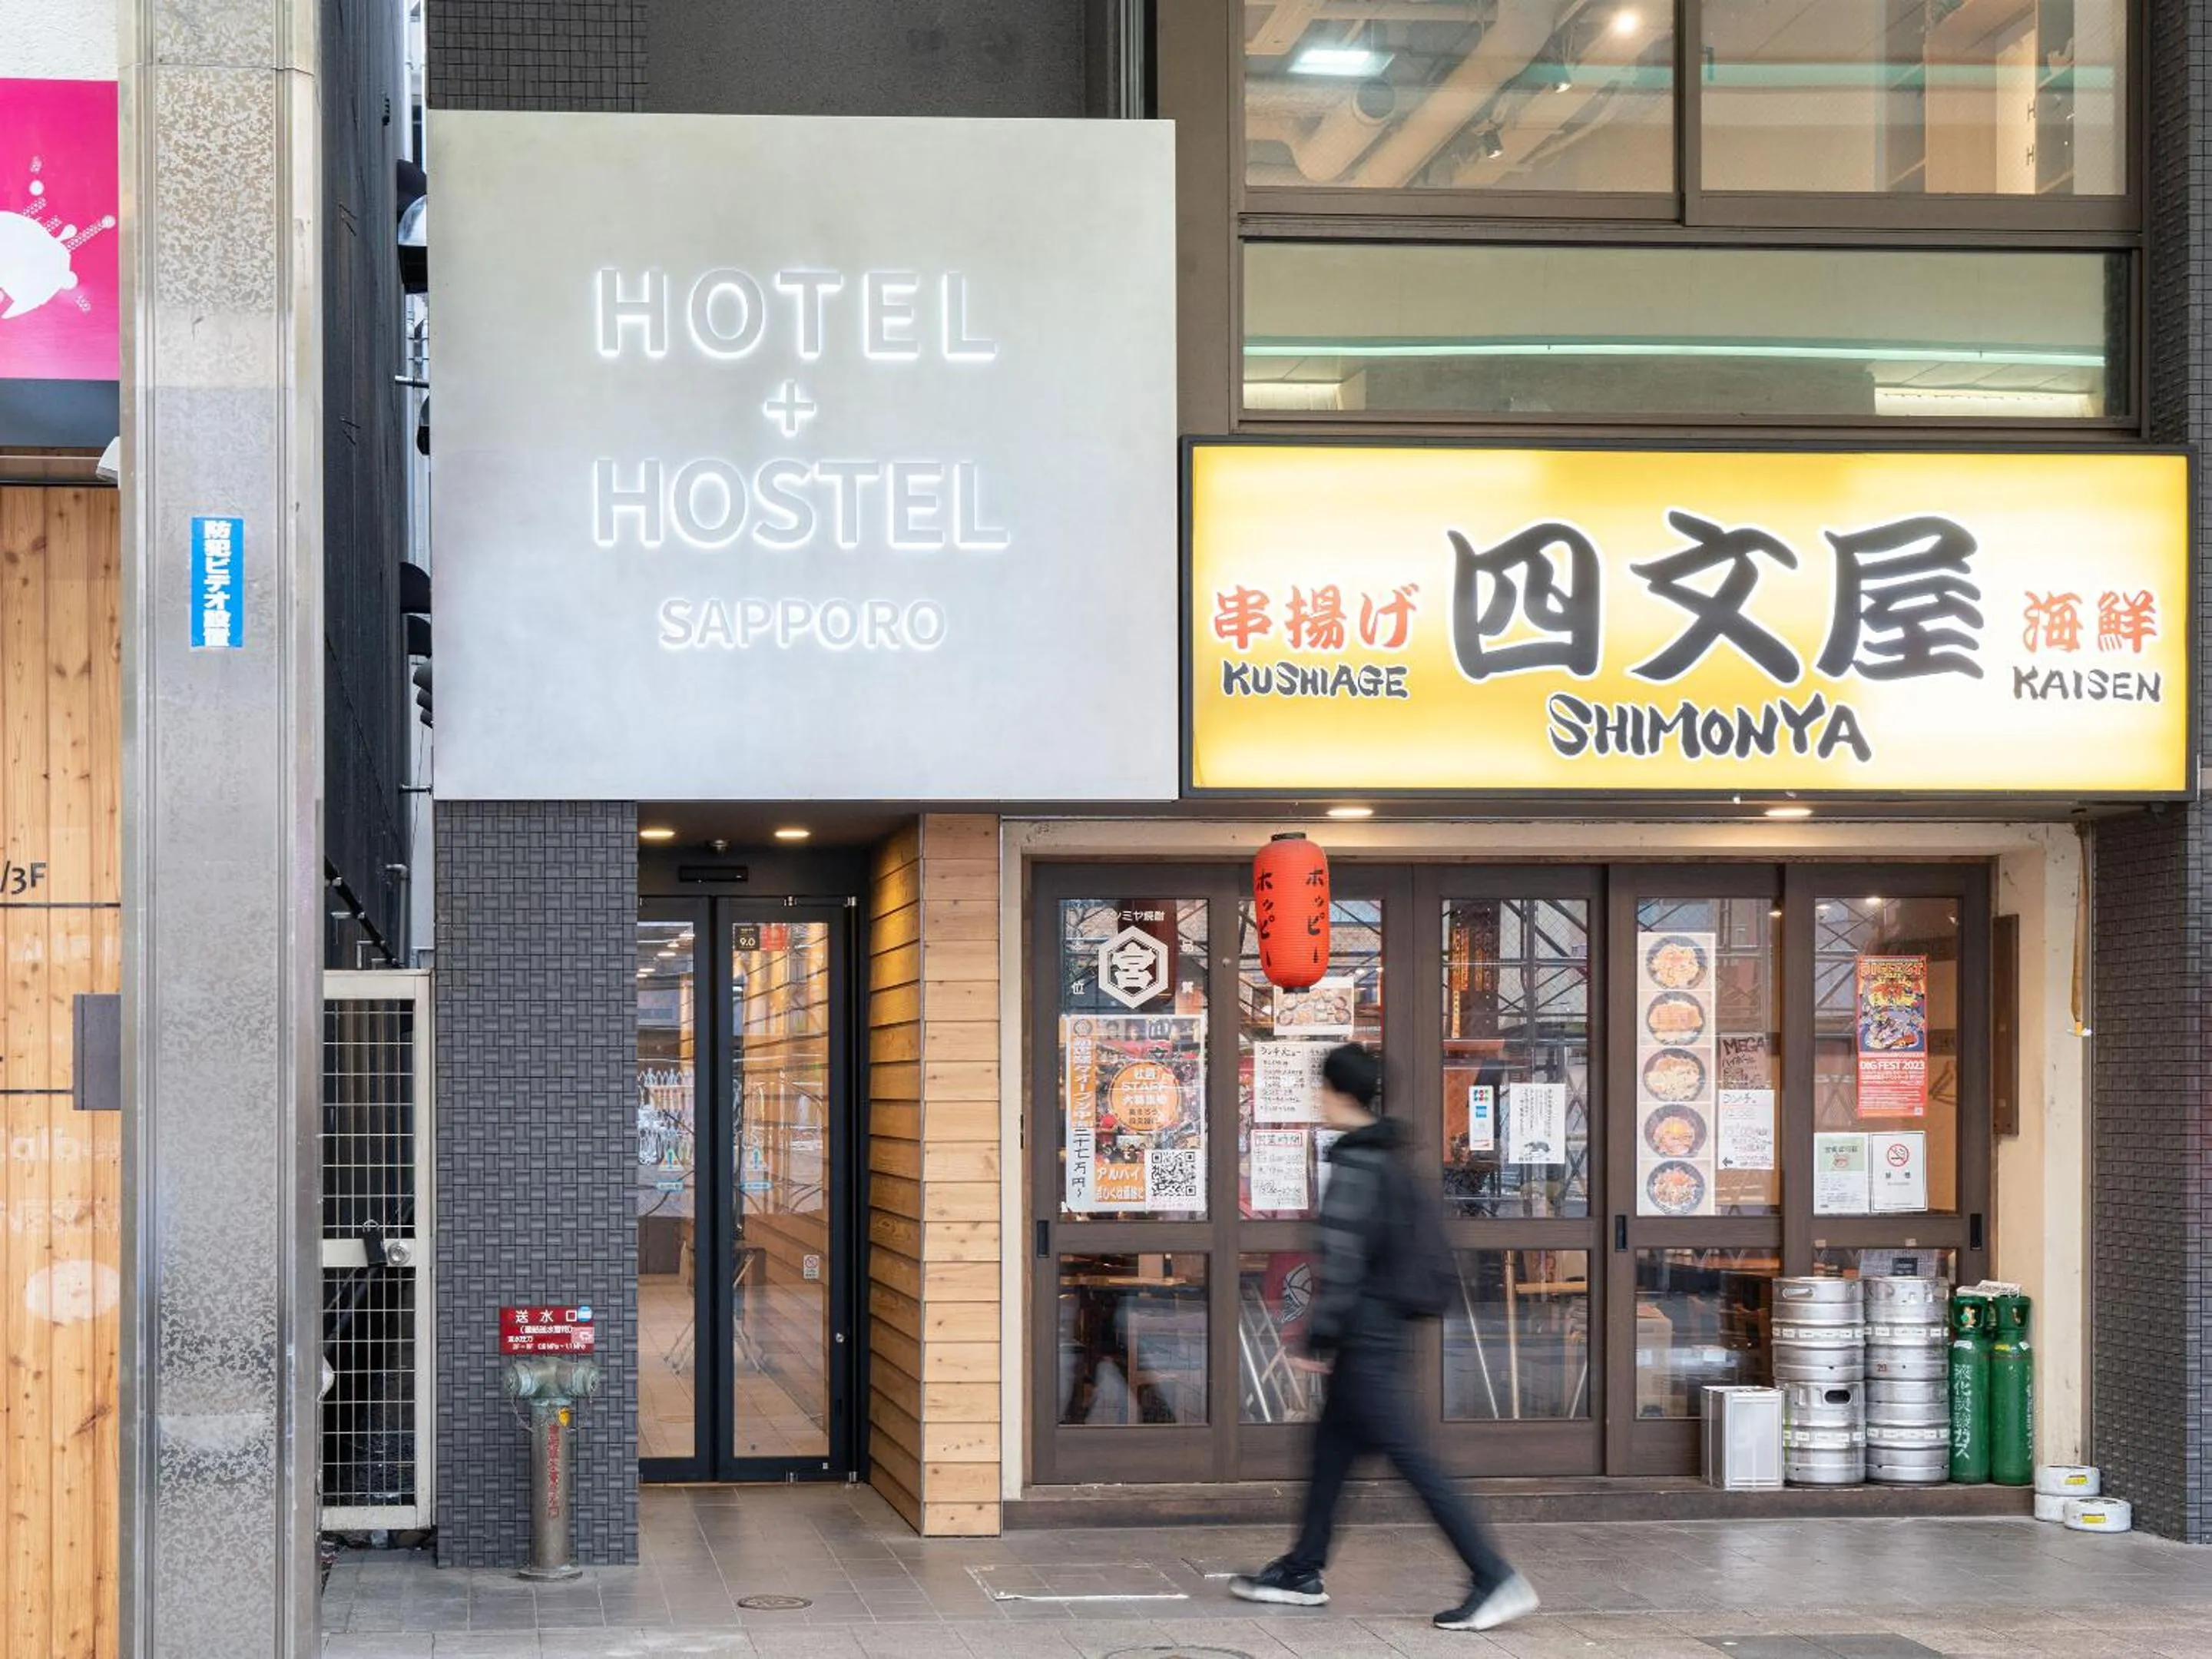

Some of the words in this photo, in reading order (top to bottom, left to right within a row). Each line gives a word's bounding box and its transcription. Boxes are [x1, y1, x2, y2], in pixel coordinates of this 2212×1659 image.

[598, 269, 997, 358] HOTEL
[594, 459, 1010, 548] HOSTEL
[660, 598, 945, 650] SAPPORO
[1214, 584, 1419, 650] 串揚げ
[1447, 511, 1984, 683] 四文屋
[2022, 590, 2159, 653] 海鮮
[1223, 661, 1409, 697] KUSHIAGE
[2012, 664, 2162, 702] KAISEN
[1548, 694, 1873, 762] SHIMONYA
[739, 937, 756, 947] 9.0
[1256, 869, 1275, 968] ホッピー
[1306, 868, 1326, 963] ホッピー
